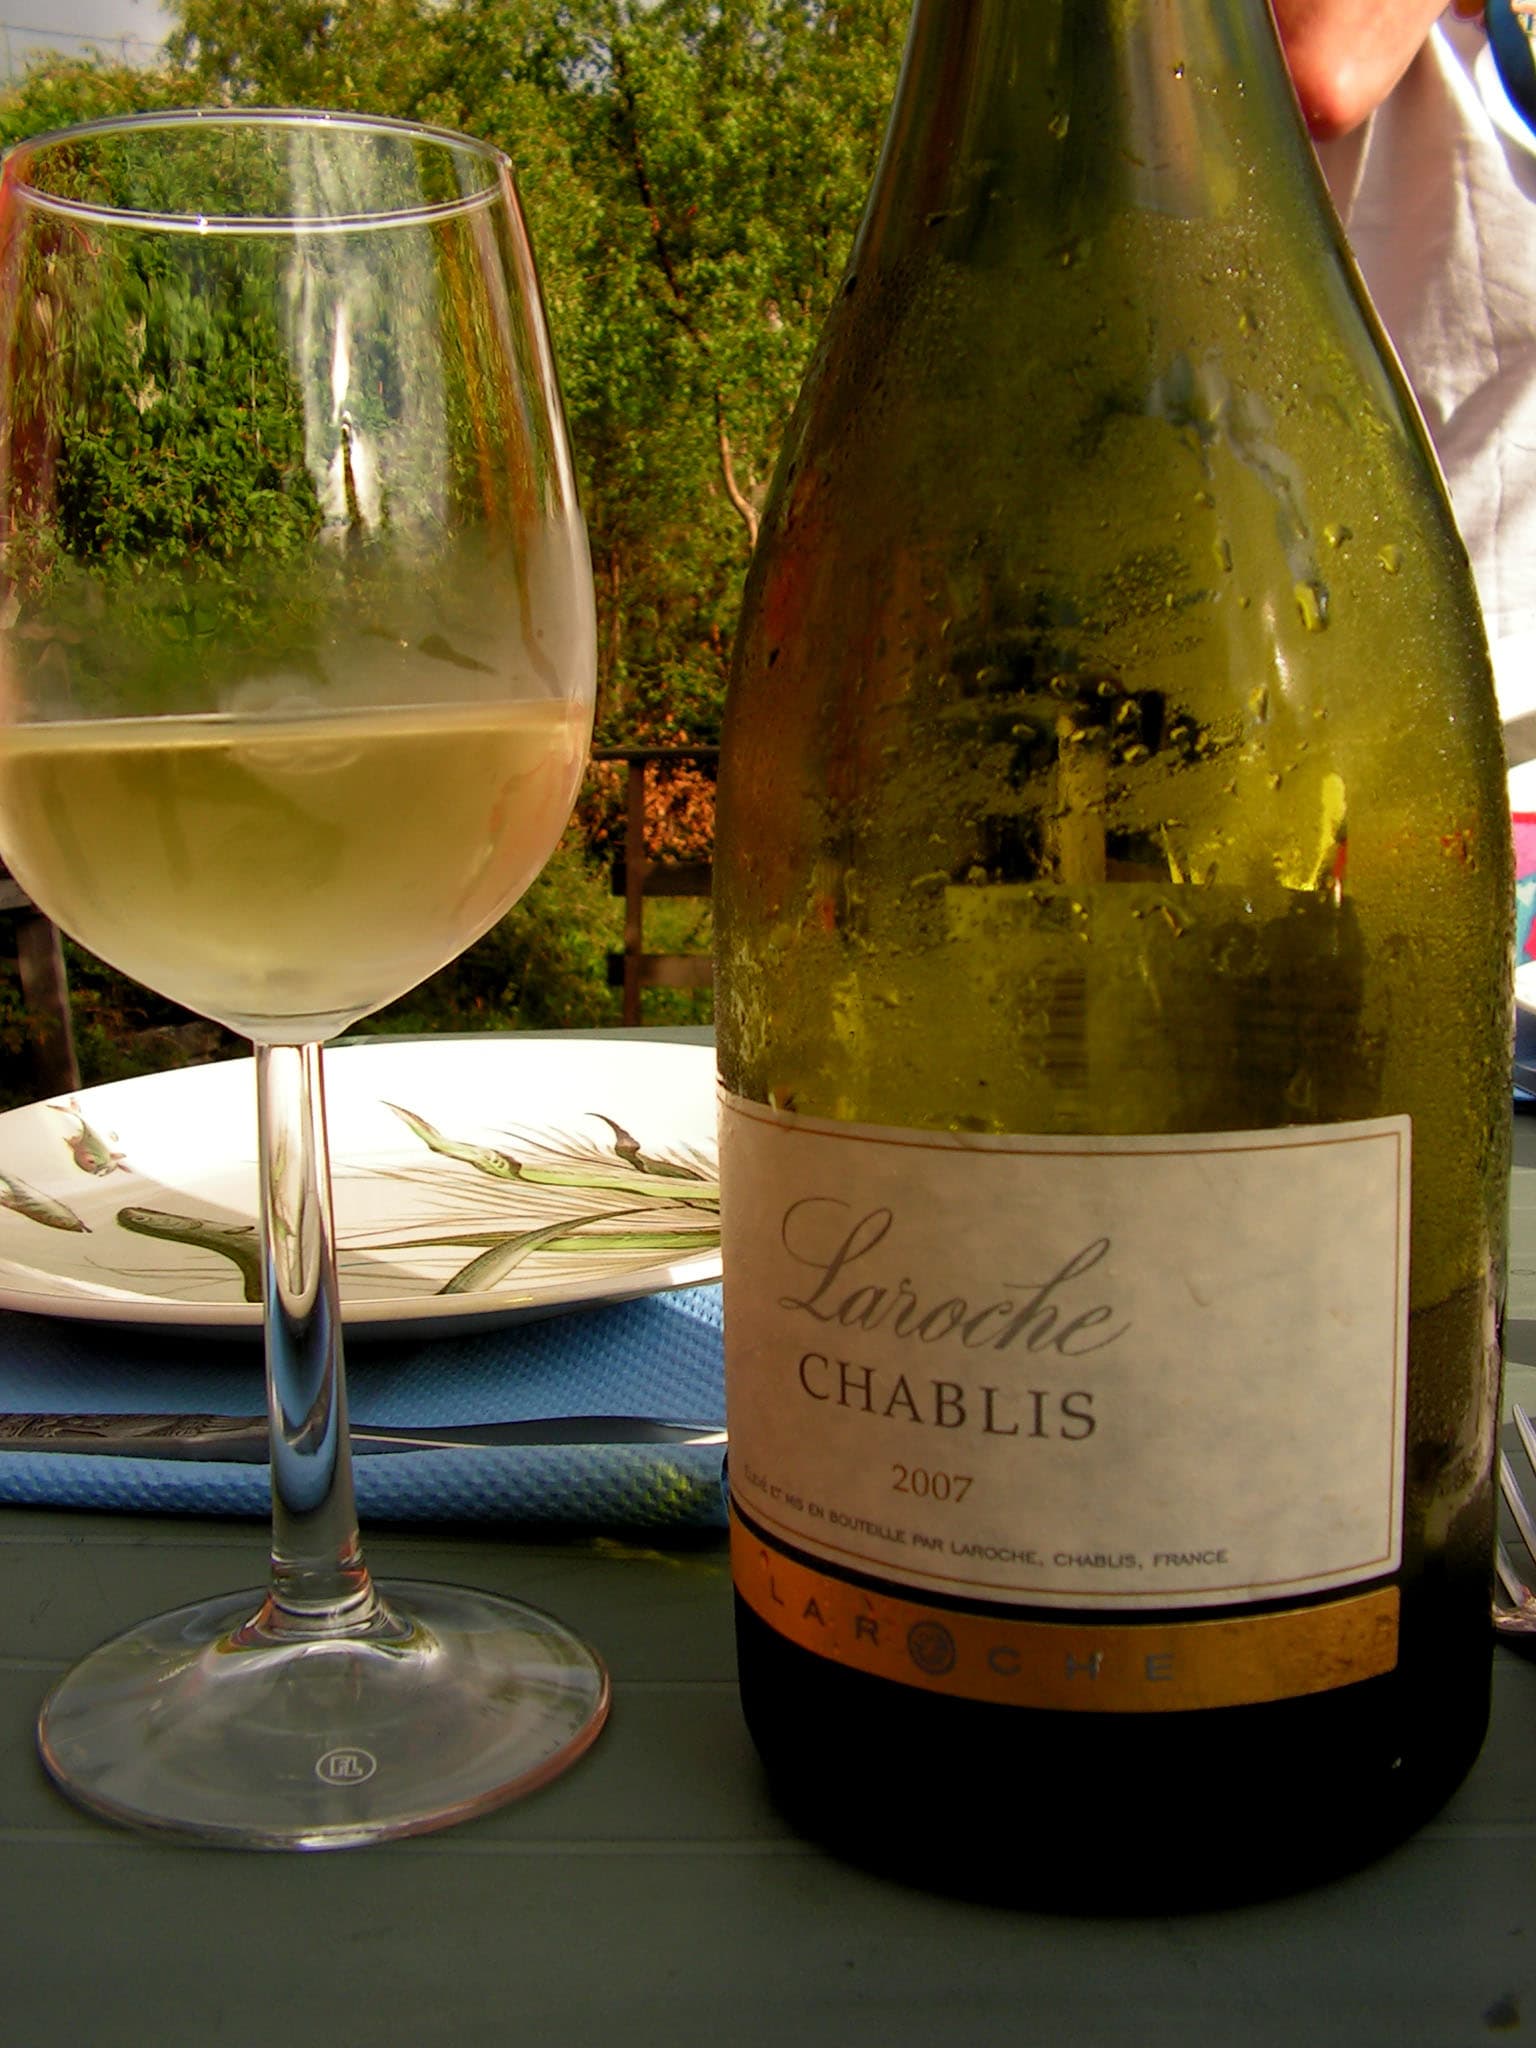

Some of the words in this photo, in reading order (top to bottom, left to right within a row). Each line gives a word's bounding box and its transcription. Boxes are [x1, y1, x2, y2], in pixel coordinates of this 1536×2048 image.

[780, 1196, 1130, 1357] Laroche
[799, 1353, 1098, 1441] CHABLIS
[890, 1463, 974, 1504] 2007
[808, 1502, 825, 1519] EN
[829, 1510, 907, 1545] BOUTEILLE
[912, 1532, 944, 1551] PAR
[950, 1540, 1044, 1567] LAROCHE,
[1053, 1552, 1143, 1570] CHABLIS,
[1152, 1549, 1229, 1568] FRANCE
